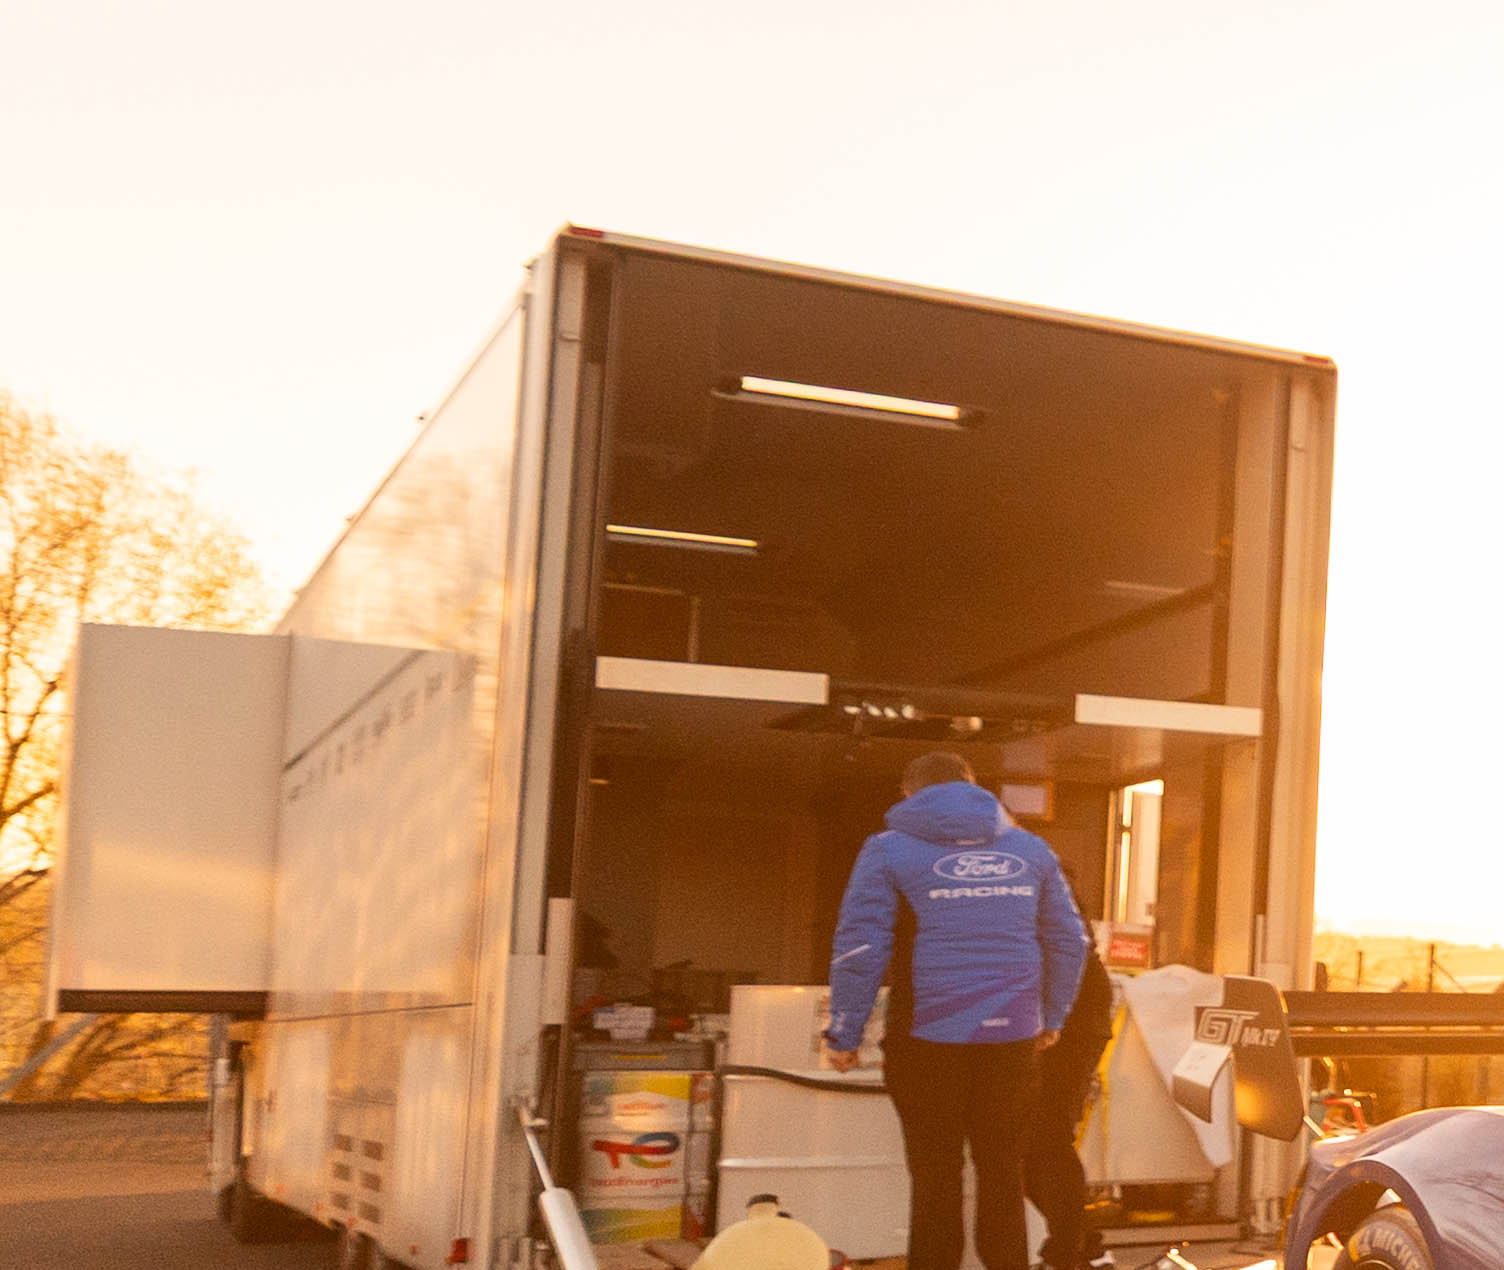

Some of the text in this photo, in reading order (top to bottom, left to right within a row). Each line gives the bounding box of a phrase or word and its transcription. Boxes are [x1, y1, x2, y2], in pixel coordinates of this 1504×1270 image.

[952, 854, 1011, 876] Ford
[929, 886, 1034, 899] RACING
[1197, 1008, 1259, 1046] GT
